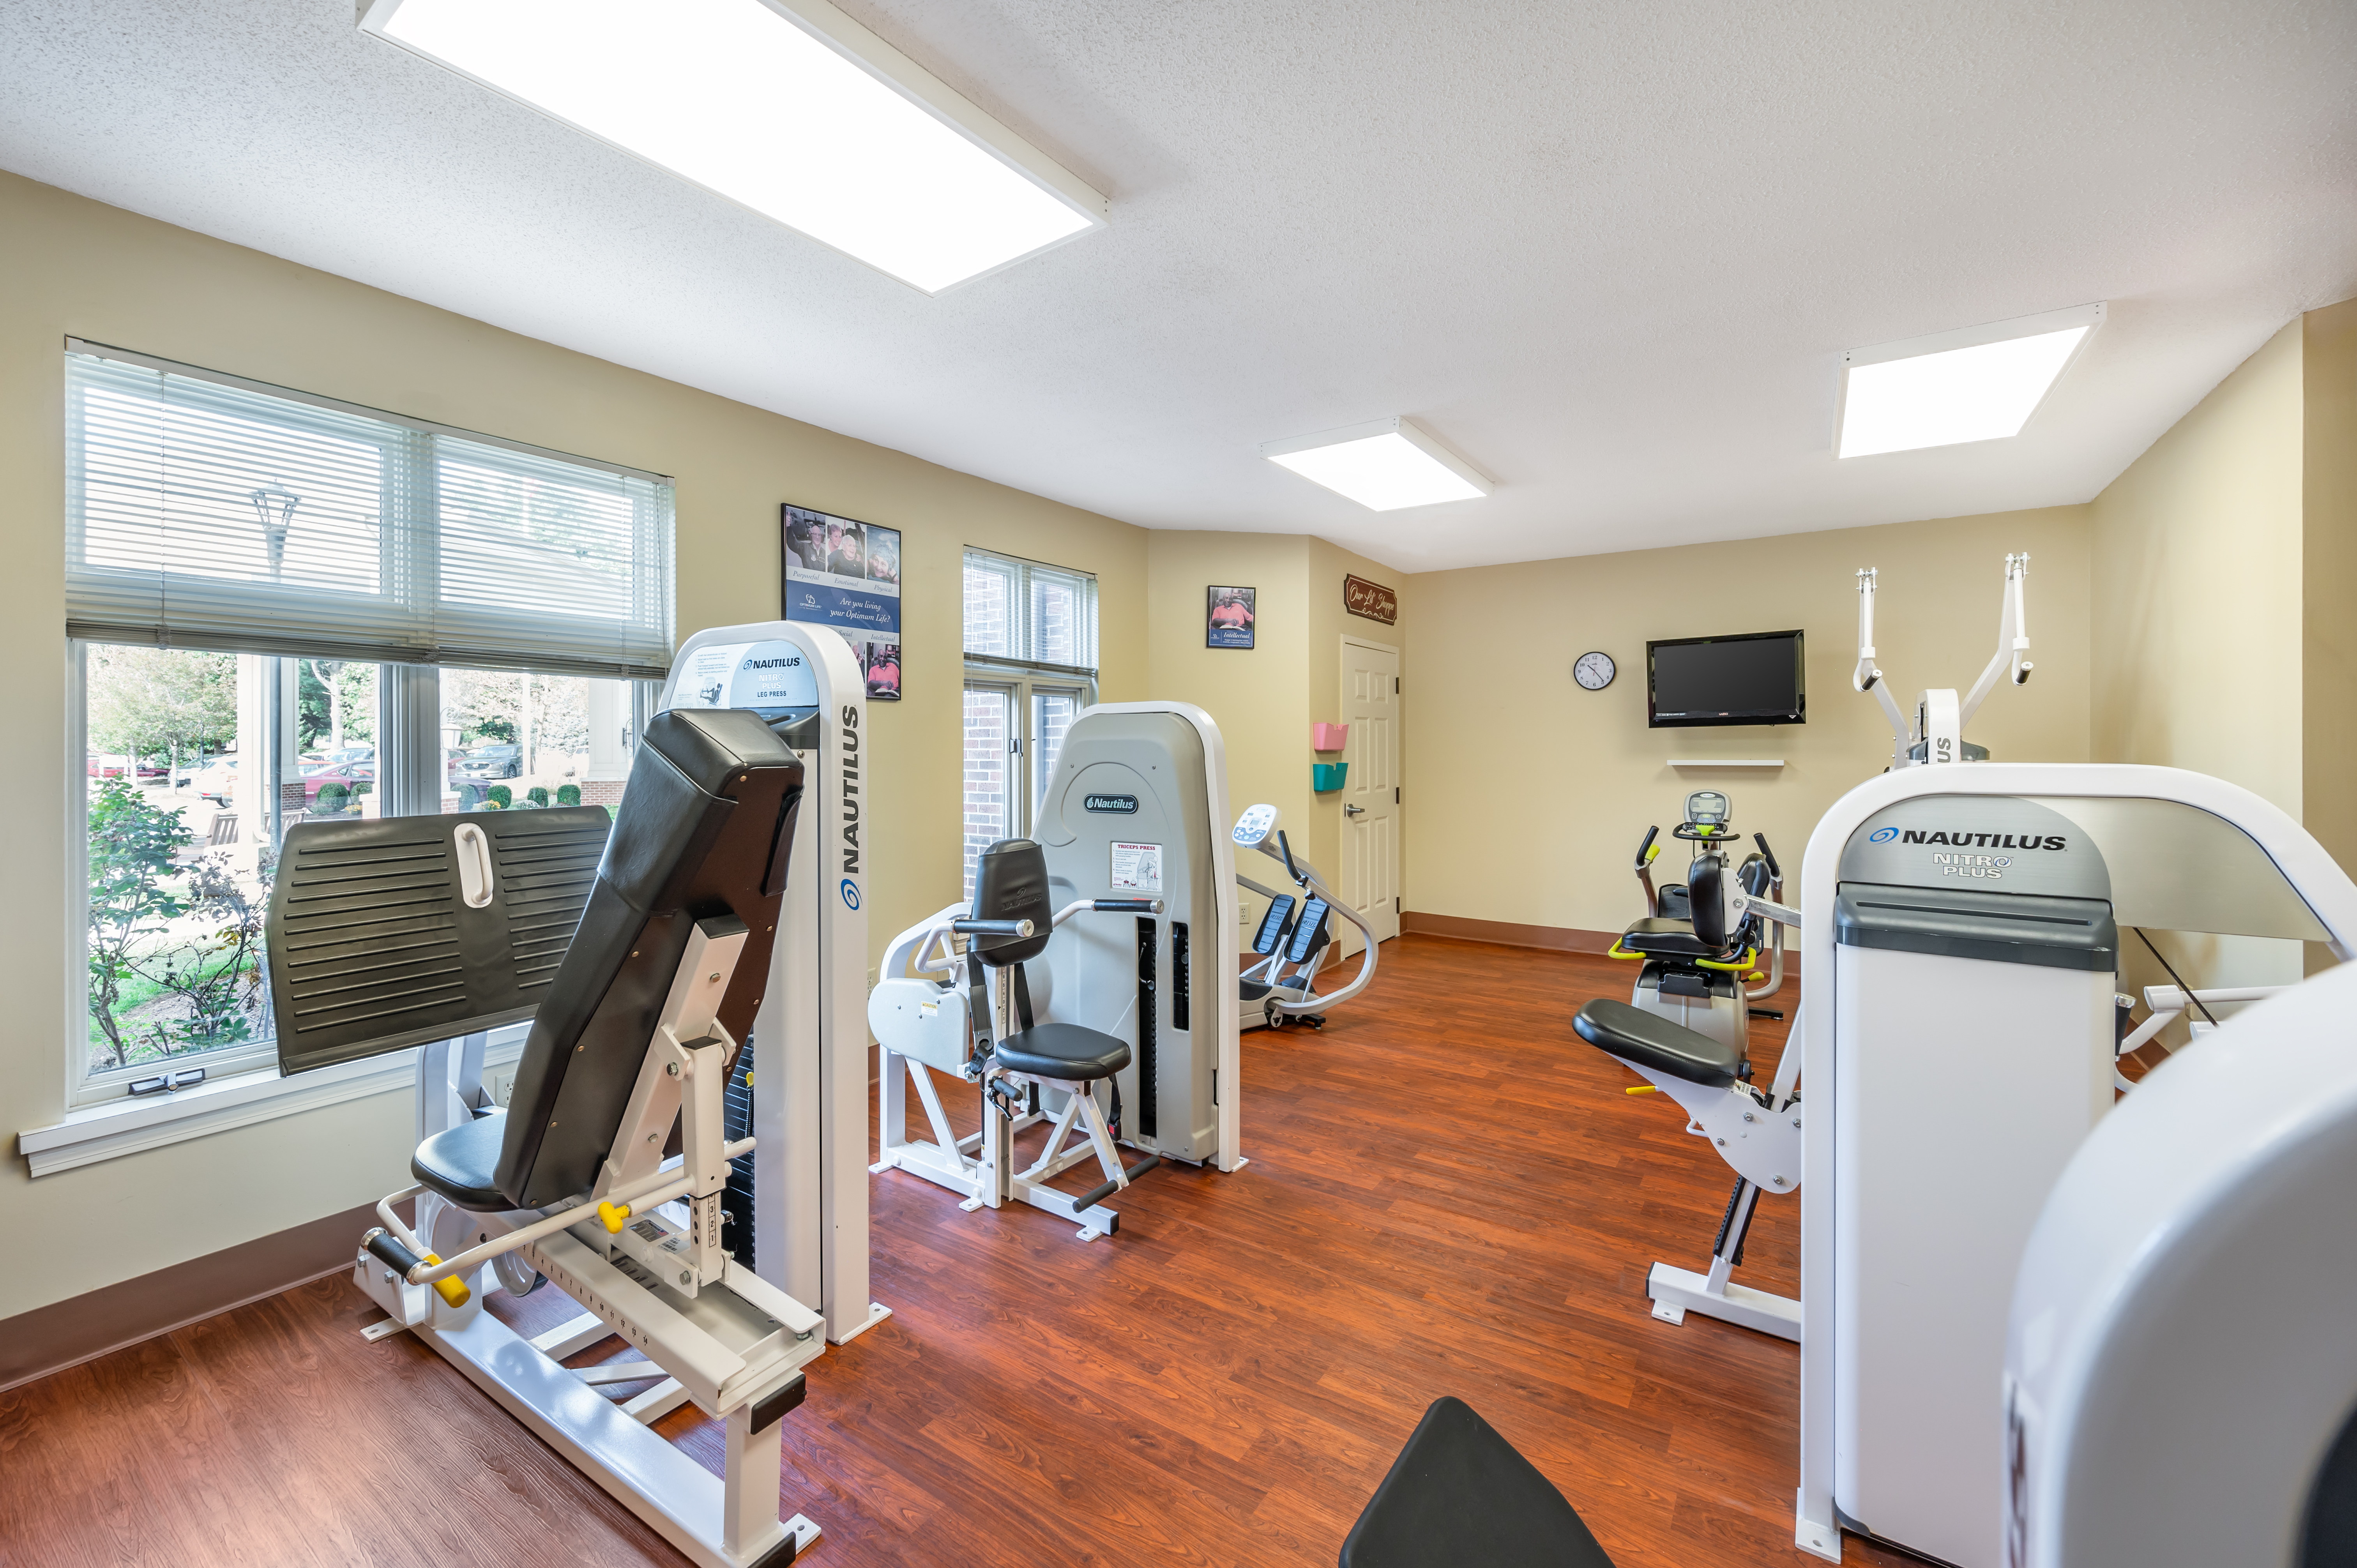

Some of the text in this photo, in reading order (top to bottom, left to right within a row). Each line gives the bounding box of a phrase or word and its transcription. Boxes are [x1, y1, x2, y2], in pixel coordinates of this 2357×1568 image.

[793, 570, 820, 581] Purposeful
[834, 578, 859, 587] Emotional
[1350, 584, 1363, 601] Our
[1376, 593, 1394, 616] Shoppe
[865, 601, 881, 612] living
[846, 610, 874, 621] Optimum
[876, 614, 891, 623] Life?
[871, 634, 895, 642] Intellectual
[753, 657, 800, 669] NAUTILUS
[759, 673, 784, 682] NITRO
[842, 705, 859, 874] NAUTILUS
[1094, 798, 1133, 809] Nautilus
[1902, 830, 2066, 851] NAUTILUS
[1933, 853, 2012, 868] NITRO
[1944, 866, 2002, 879] PLUS
[1001, 893, 1042, 911] NAUTILUS
